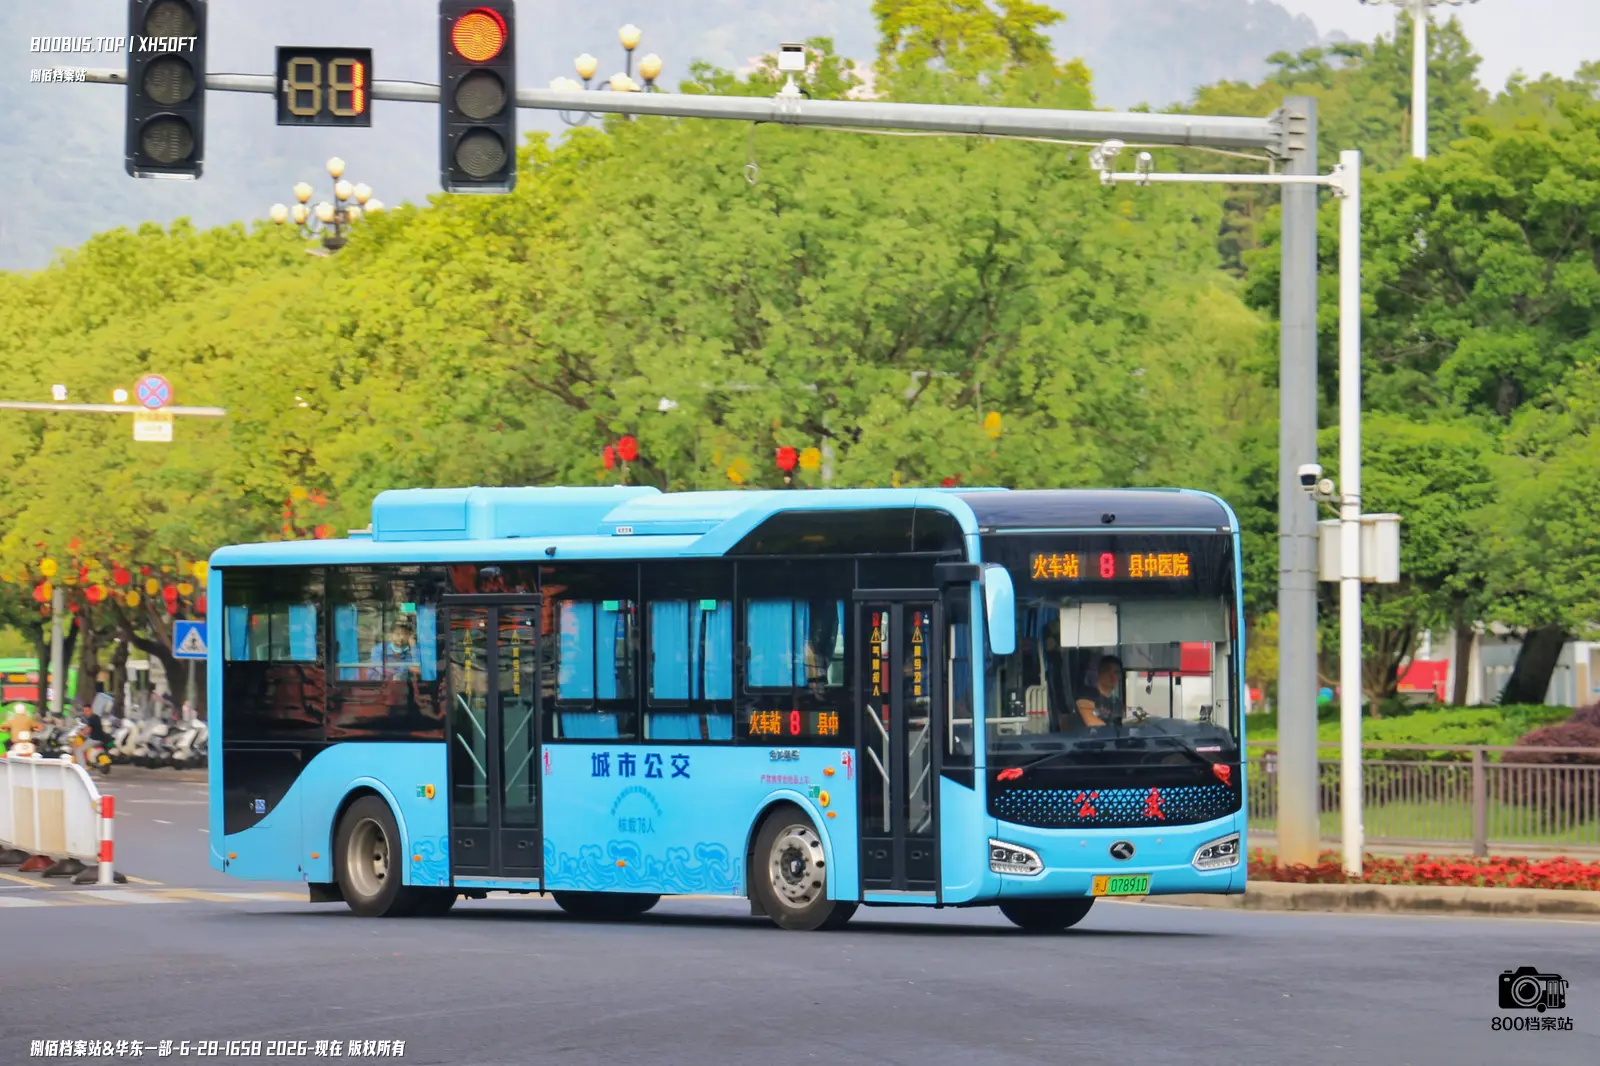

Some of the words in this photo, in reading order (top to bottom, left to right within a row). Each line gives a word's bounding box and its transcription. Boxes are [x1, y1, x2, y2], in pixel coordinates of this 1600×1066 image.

[1032, 553, 1079, 579] 火车站
[1100, 552, 1115, 579] 8
[1128, 552, 1190, 578] 县中医院
[749, 711, 781, 736] 火车站
[789, 710, 801, 736] 8
[817, 711, 839, 736] 县中
[591, 752, 691, 779] 城市公交
